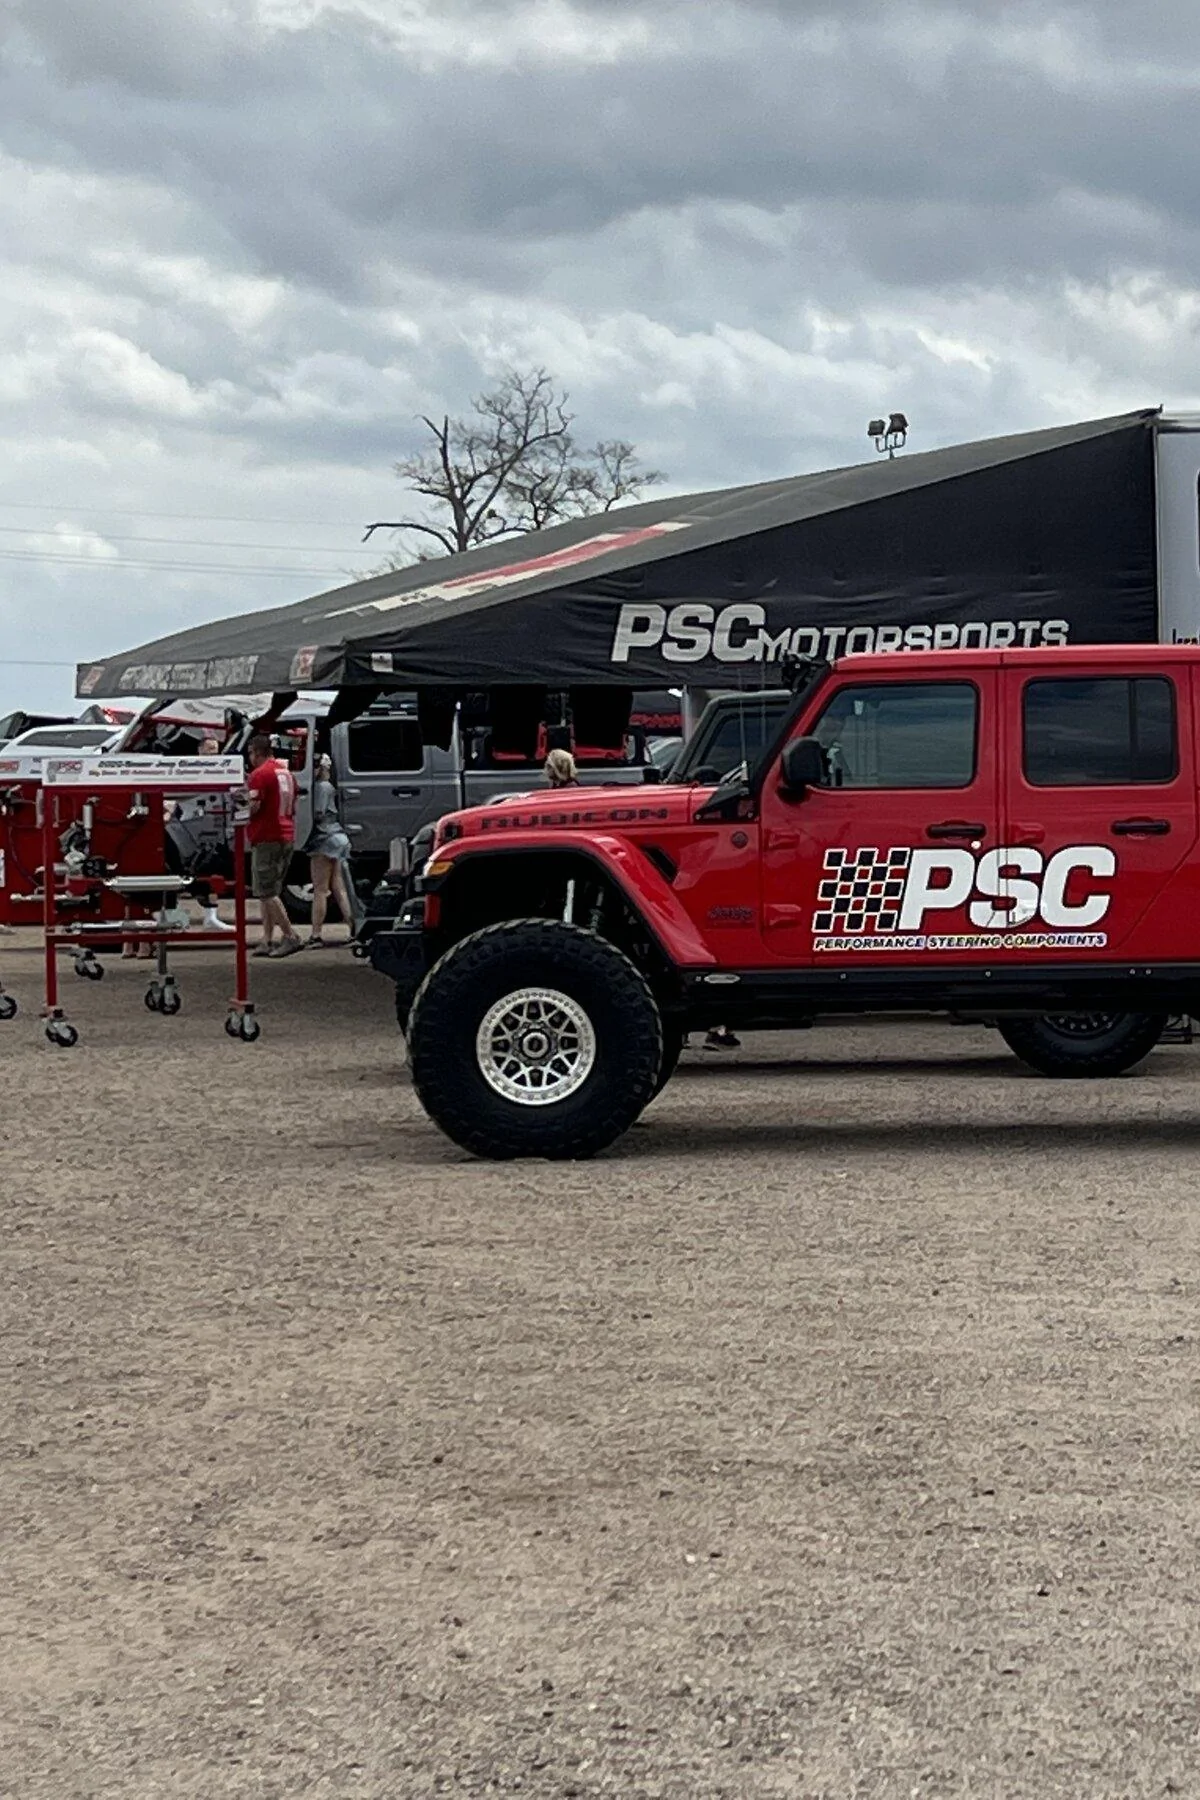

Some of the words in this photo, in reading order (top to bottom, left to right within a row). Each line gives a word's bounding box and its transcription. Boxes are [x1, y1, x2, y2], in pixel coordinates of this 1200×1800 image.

[611, 603, 765, 662] PSC
[755, 619, 1070, 662] MOTORSPORTS
[482, 808, 669, 830] RUBICON
[898, 846, 1116, 932] PSC
[814, 935, 924, 950] PERFORMANCE
[928, 934, 1001, 949] STEERING
[1003, 932, 1107, 948] COMPONENTS
